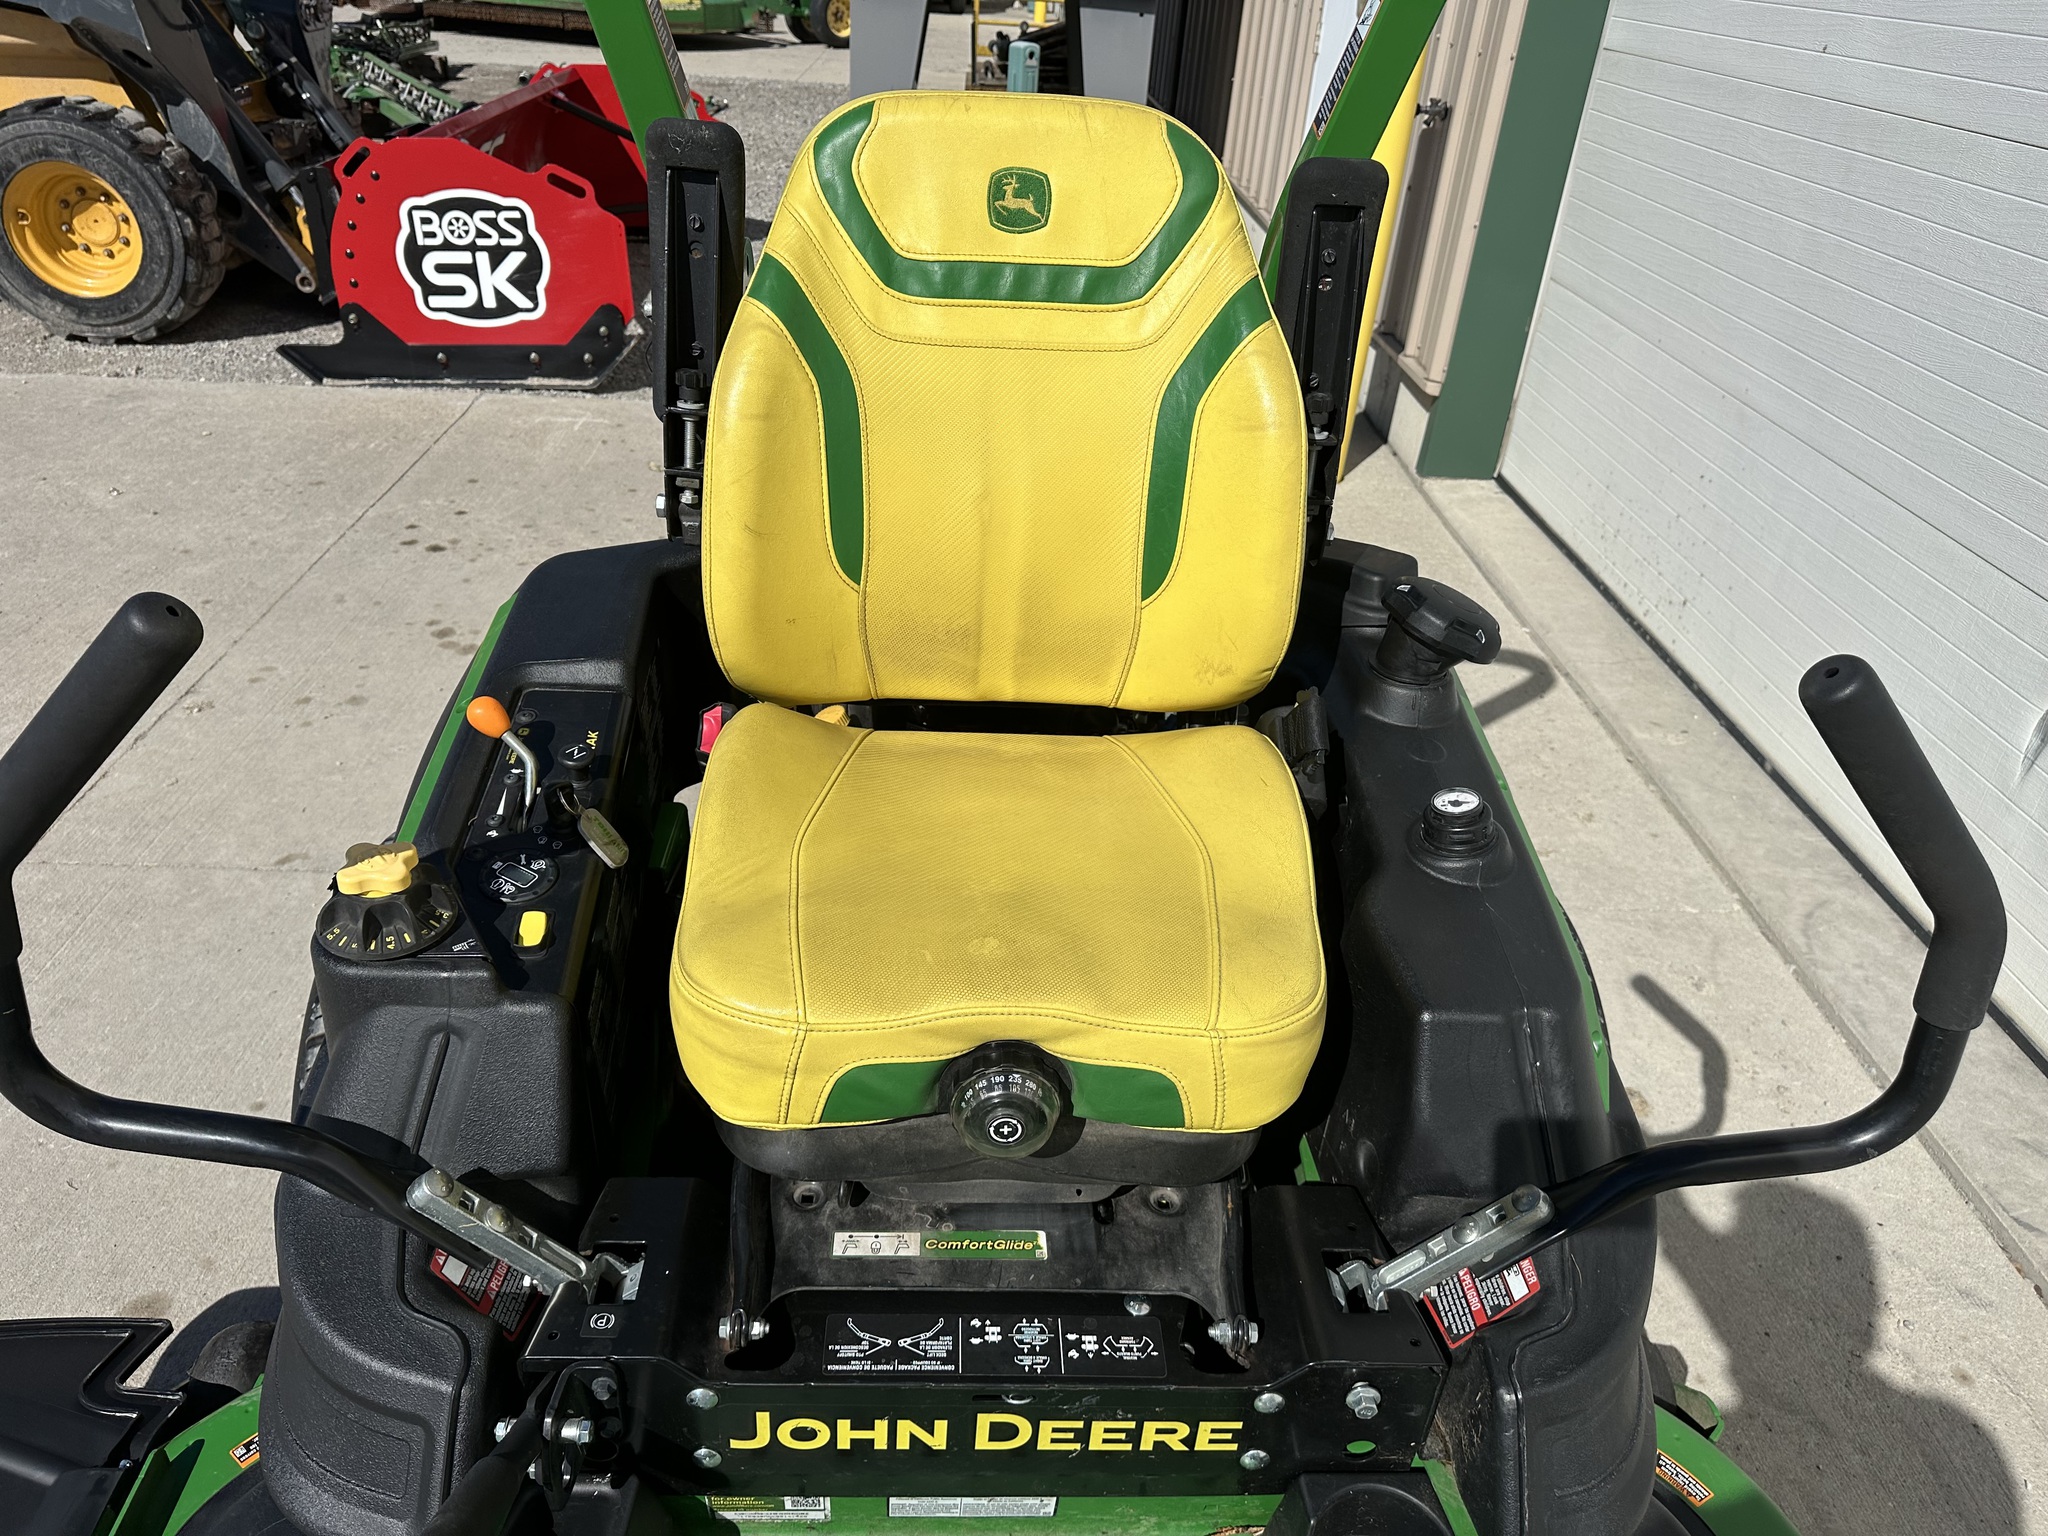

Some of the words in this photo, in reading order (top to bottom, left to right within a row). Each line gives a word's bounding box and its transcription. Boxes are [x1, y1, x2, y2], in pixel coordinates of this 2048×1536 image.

[412, 210, 523, 245] BOSS
[422, 251, 534, 308] SK
[326, 927, 341, 941] 5.5
[385, 935, 396, 950] 4.5
[964, 1088, 974, 1101] 100
[974, 1079, 987, 1090] 145
[990, 1075, 1005, 1083] 190
[1008, 1075, 1022, 1084] 235
[1025, 1079, 1037, 1091] 280
[924, 1239, 1034, 1250] ComfortGlide
[1520, 1260, 1536, 1284] NGER
[1461, 1275, 1480, 1310] PELIGRO
[729, 1411, 948, 1450] JOHN
[974, 1413, 1244, 1451] DEERE
